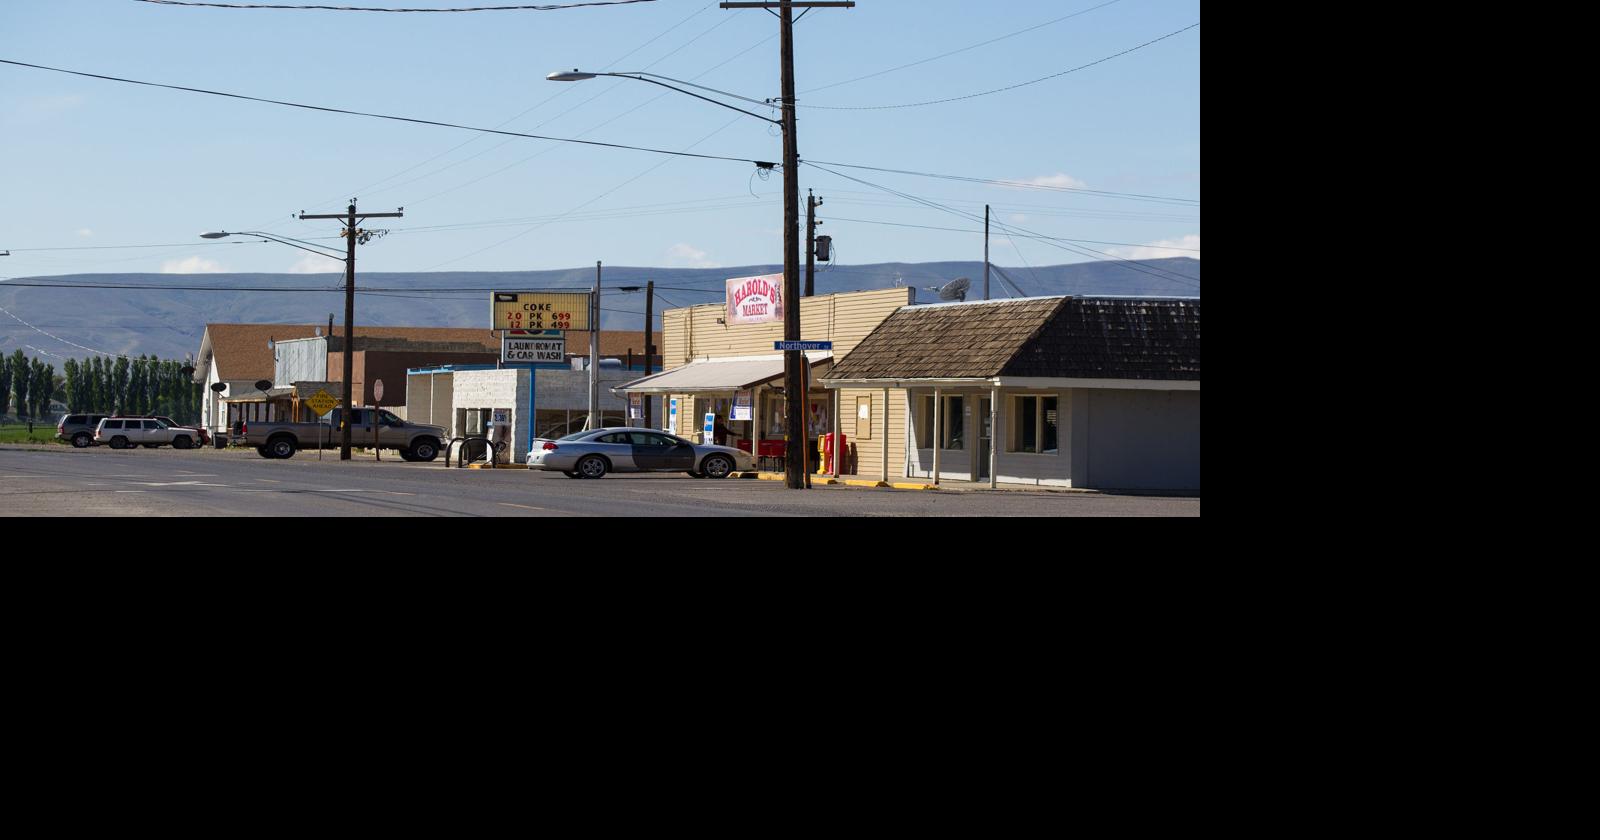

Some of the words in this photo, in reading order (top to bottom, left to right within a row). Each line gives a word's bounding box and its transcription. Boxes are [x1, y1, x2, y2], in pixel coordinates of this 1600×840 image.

[734, 279, 776, 307] HAROLD'S
[523, 303, 552, 311] COKE
[742, 303, 768, 317] MARKET
[507, 312, 522, 320] 20
[529, 312, 543, 320] PK
[551, 312, 571, 320] 699
[510, 321, 521, 329] 12
[529, 321, 543, 329] PK
[551, 321, 571, 329] 499
[779, 341, 821, 350] Northover
[507, 351, 515, 360] &
[516, 351, 534, 360] CAR
[537, 351, 562, 360] WASH
